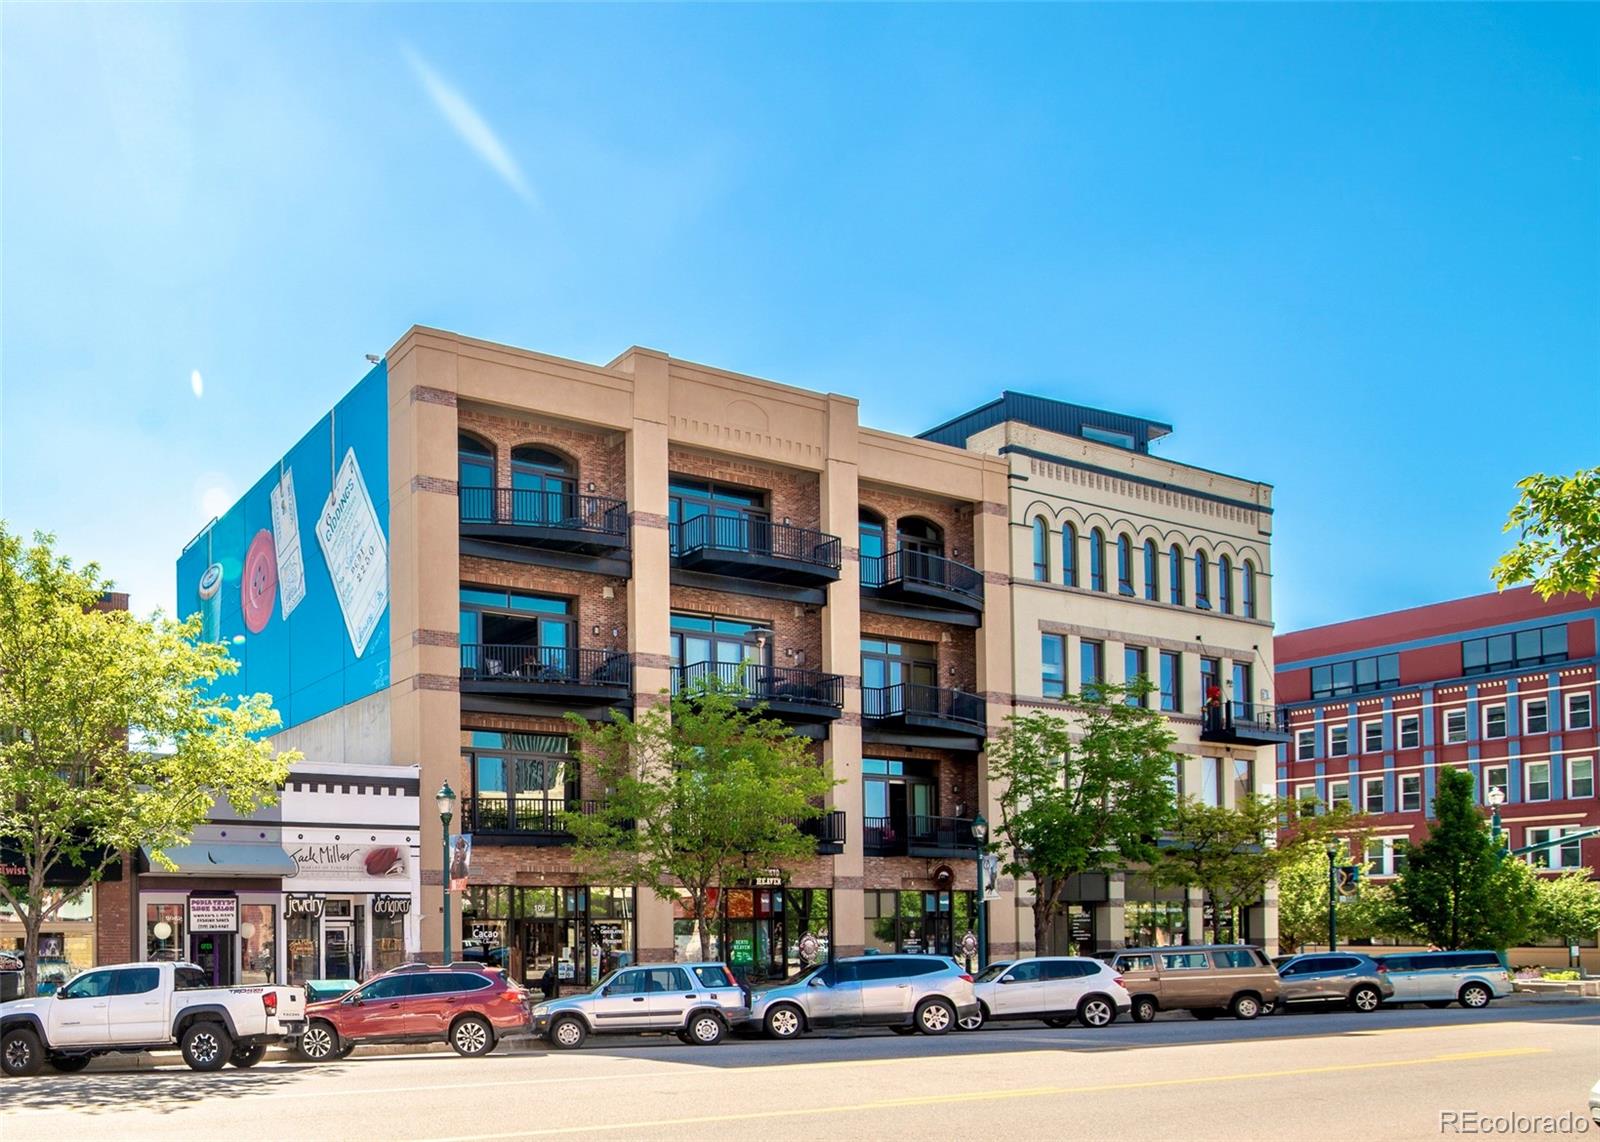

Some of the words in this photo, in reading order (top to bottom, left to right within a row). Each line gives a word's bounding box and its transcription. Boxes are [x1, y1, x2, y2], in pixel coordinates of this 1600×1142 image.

[325, 478, 355, 542] GIDDINGS
[288, 846, 319, 877] Jack
[319, 844, 360, 864] Miller
[286, 895, 323, 917] jewelry
[374, 896, 410, 918] designers
[534, 904, 546, 912] 109
[472, 928, 499, 939] Cacao
